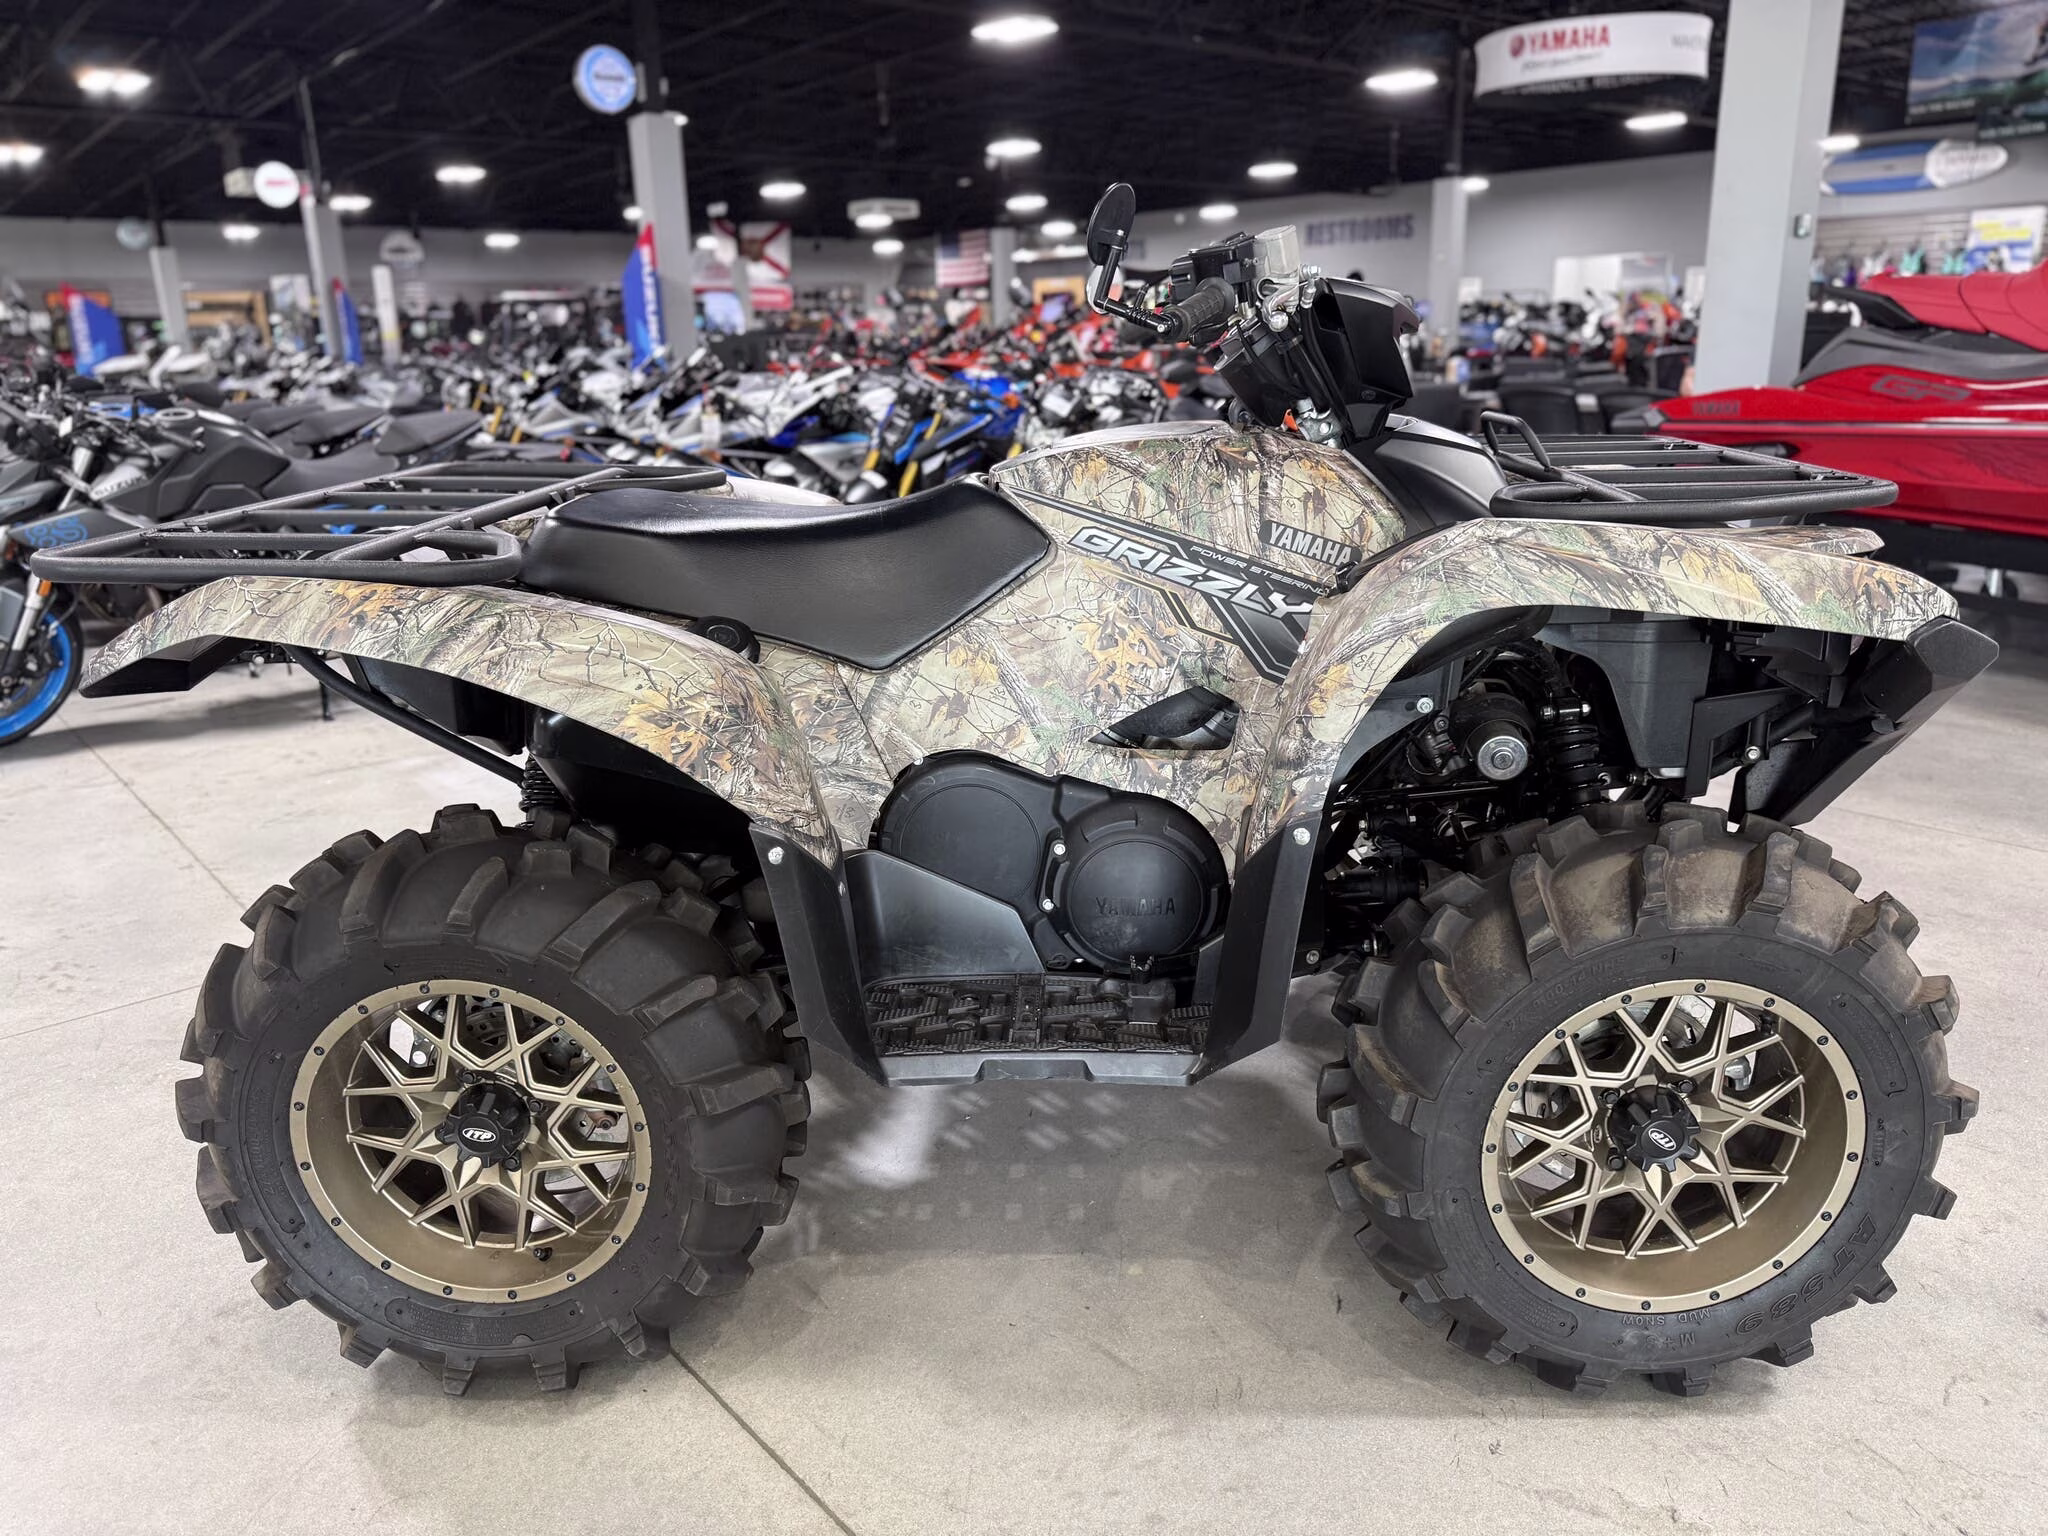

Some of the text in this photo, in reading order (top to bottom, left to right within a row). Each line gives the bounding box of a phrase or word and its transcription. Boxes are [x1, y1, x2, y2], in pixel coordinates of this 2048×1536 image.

[1529, 25, 1612, 53] YAMAHA
[1305, 213, 1414, 246] RESTROOMS
[1269, 522, 1351, 566] YAMAHA
[1190, 545, 1248, 569] POWER
[1069, 527, 1314, 618] GRIZZLY
[1096, 896, 1177, 918] YAMAHA
[464, 1128, 493, 1141] ITP
[1649, 1130, 1675, 1149] ITP
[1621, 1307, 1712, 1326] MUD SNOW
